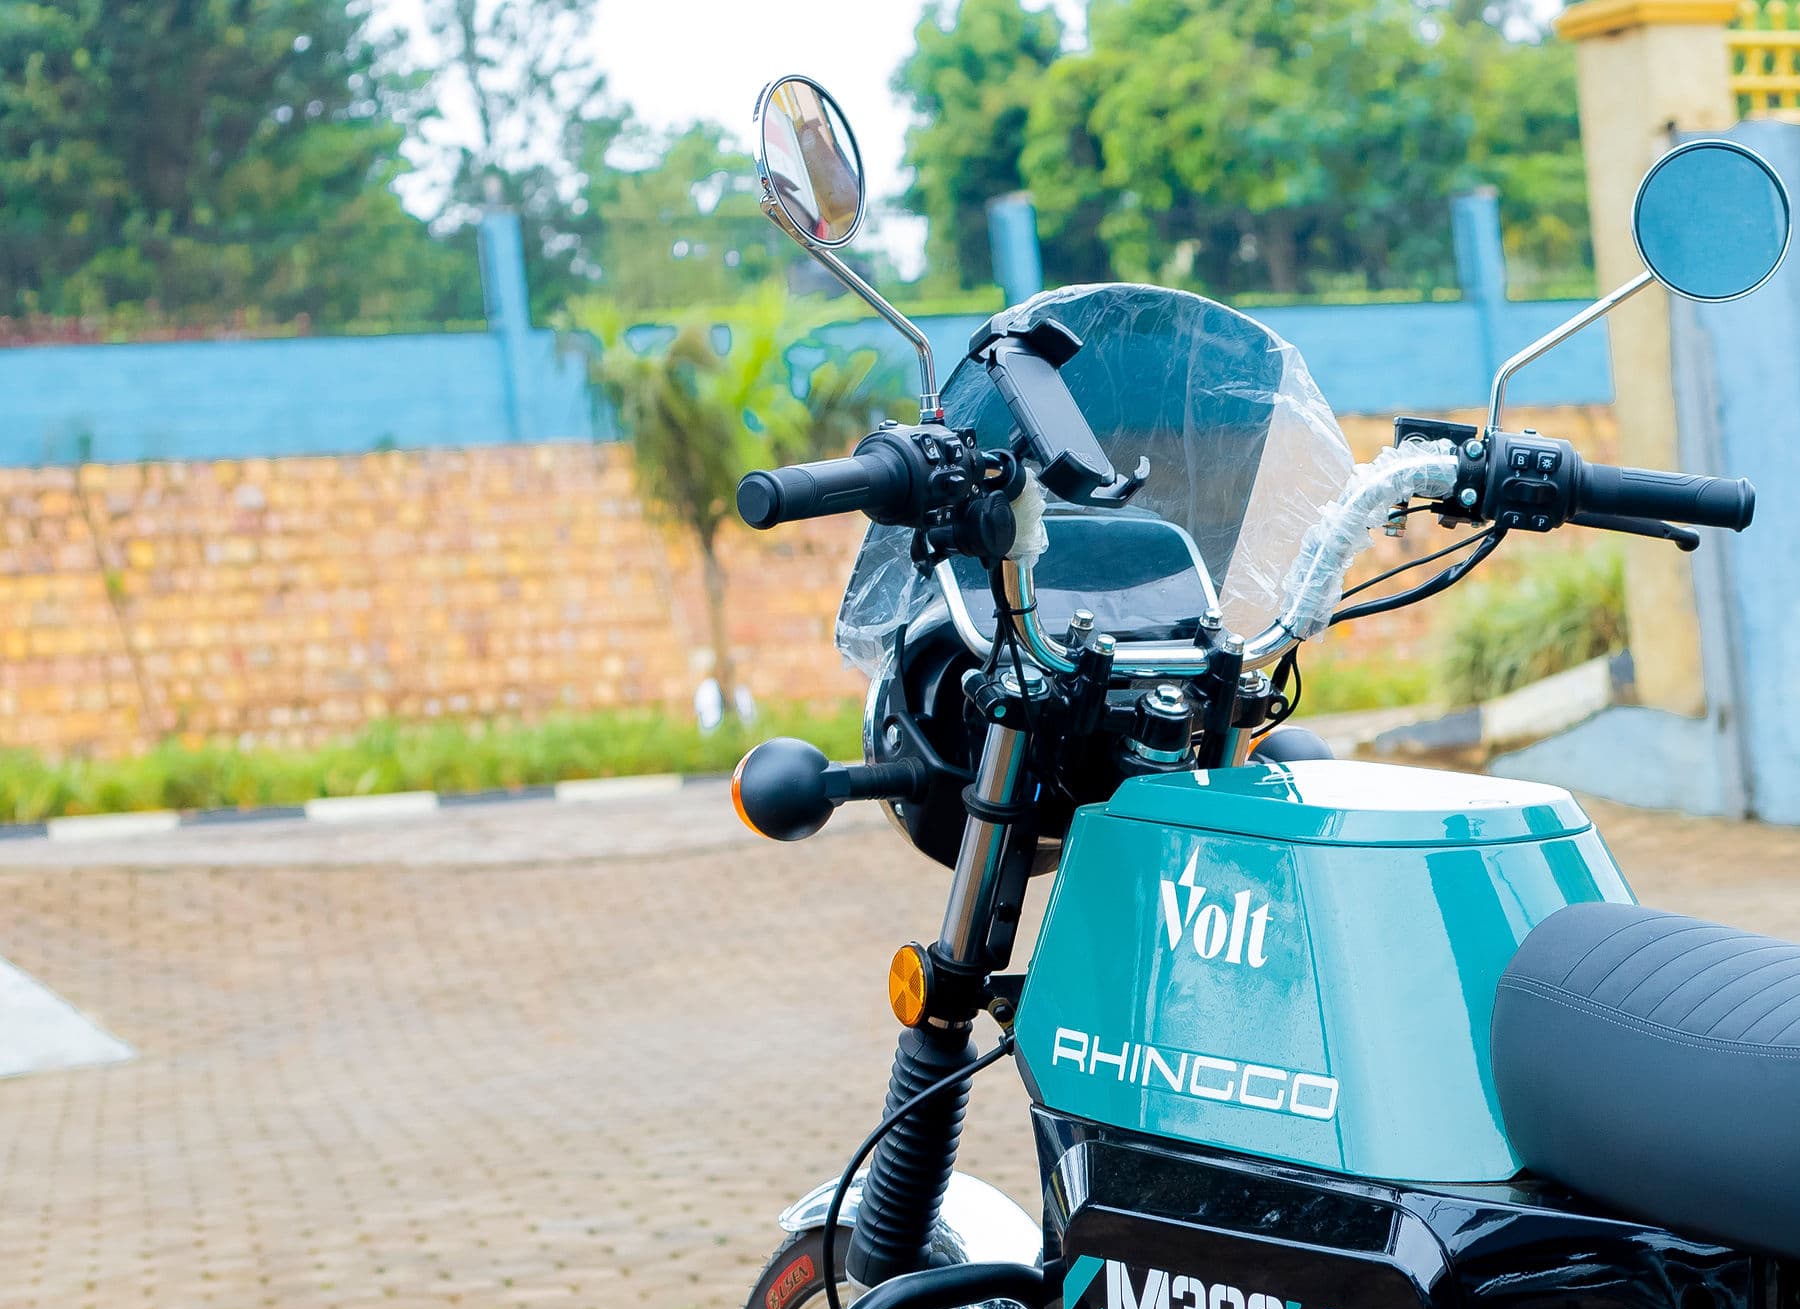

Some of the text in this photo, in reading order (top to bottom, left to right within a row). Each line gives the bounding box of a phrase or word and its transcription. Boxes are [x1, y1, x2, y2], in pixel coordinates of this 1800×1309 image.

[1517, 456, 1525, 465] B
[1160, 846, 1274, 969] Volt
[1052, 1027, 1339, 1120] RHINGGO
